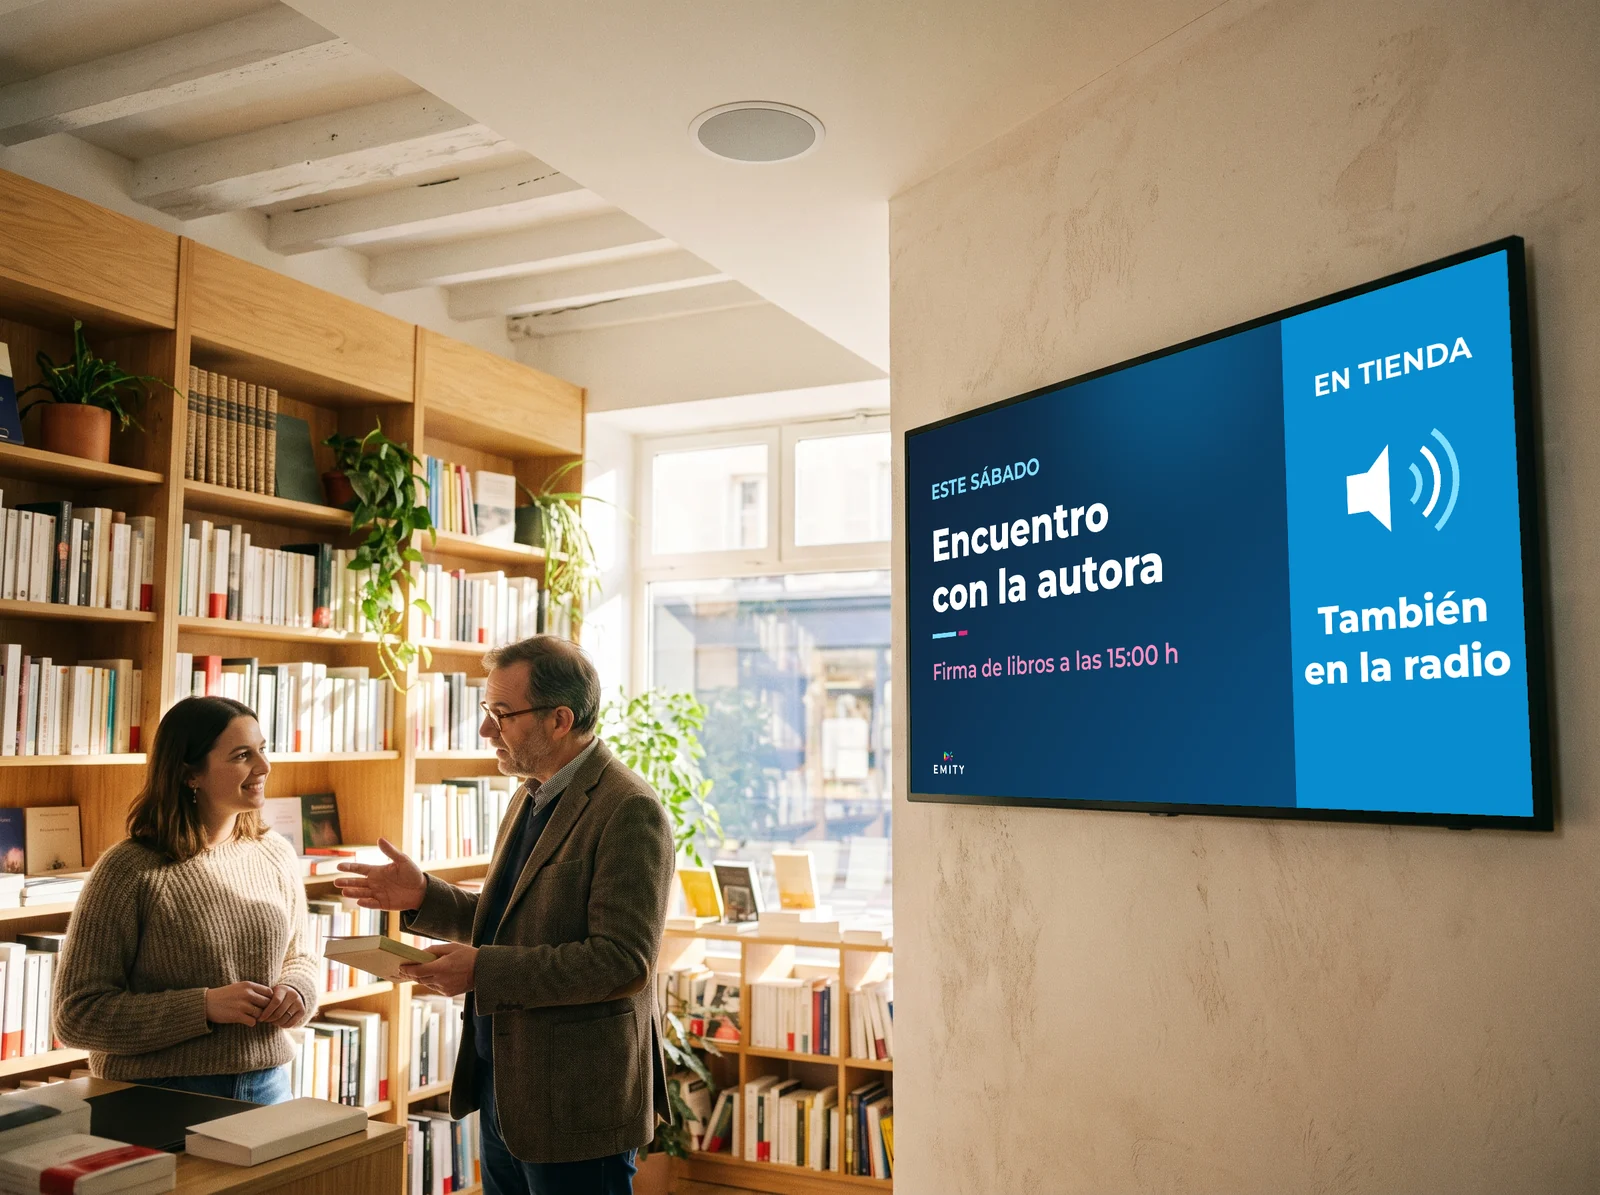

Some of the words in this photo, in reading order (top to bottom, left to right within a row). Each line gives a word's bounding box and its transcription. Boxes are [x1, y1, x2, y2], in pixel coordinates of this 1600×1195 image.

[1314, 367, 1350, 397] EN
[1357, 336, 1473, 385] TIENDA
[931, 476, 967, 501] ESTE
[970, 457, 1040, 491] SÁBADO
[932, 502, 1109, 563] Encuentro
[932, 580, 988, 613] con
[998, 567, 1027, 605] la
[1037, 552, 1163, 599] autora
[1317, 590, 1488, 635] También
[933, 661, 977, 681] Firma
[981, 657, 1003, 678] de
[1007, 650, 1055, 676] libros
[1059, 656, 1070, 672] a
[1076, 650, 1102, 671] las
[1106, 644, 1159, 669] 15:00
[1165, 642, 1179, 665] h
[1304, 660, 1348, 686] en
[1359, 651, 1392, 683] la
[1404, 640, 1511, 681] radio
[933, 764, 965, 775] EMITY
